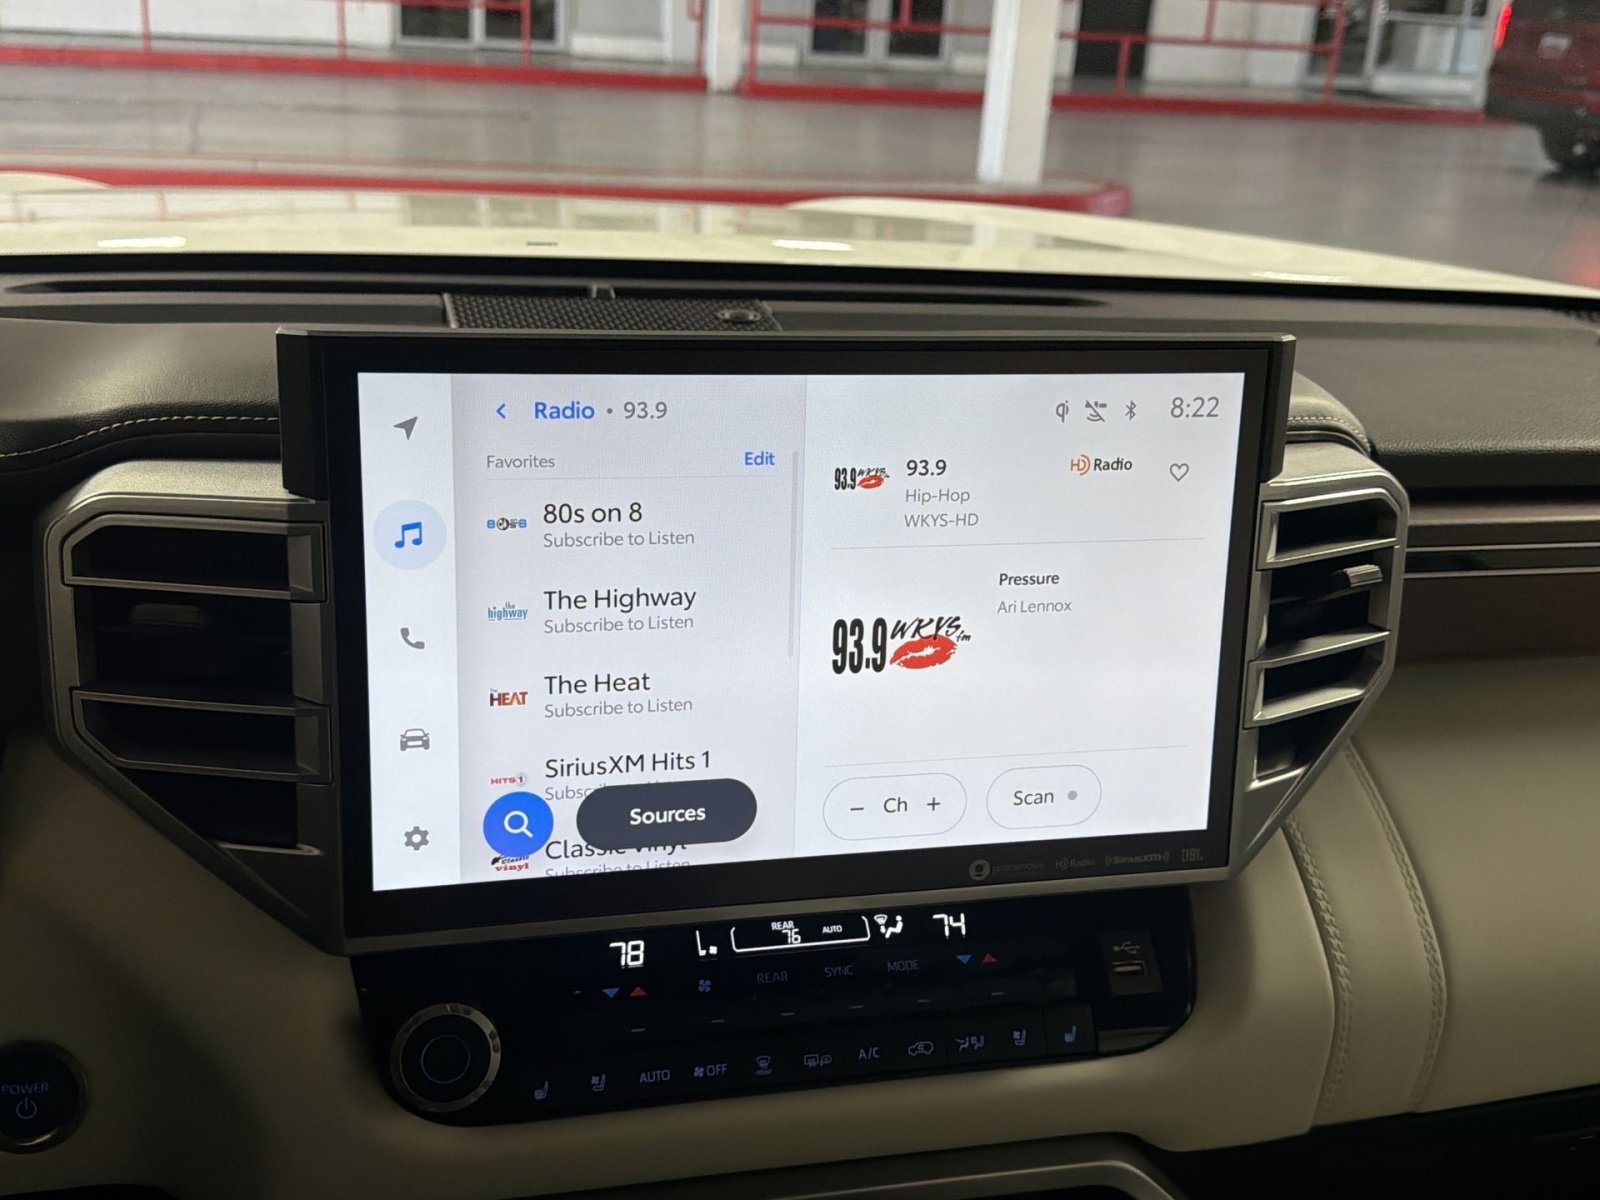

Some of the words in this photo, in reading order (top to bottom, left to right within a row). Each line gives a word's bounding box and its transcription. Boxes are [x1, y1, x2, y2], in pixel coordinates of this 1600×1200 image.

[534, 401, 595, 420] Radio
[623, 401, 668, 420] 93.9
[1170, 396, 1220, 418] 8:22
[486, 454, 555, 470] Favorites
[744, 451, 776, 467] Edit
[1093, 457, 1133, 472] Radio
[906, 459, 947, 477] 93.9
[834, 467, 857, 490] 93.9
[905, 488, 971, 504] Hip-Hop
[543, 503, 585, 524] 80s
[591, 508, 622, 523] on
[628, 502, 643, 522] 8
[904, 512, 980, 528] WKYS-HD
[543, 531, 623, 548] Subscribe
[628, 531, 645, 546] to
[648, 529, 695, 546] Listen
[999, 572, 1060, 587] Pressure
[543, 590, 588, 611] The
[594, 588, 697, 613] Highway
[997, 599, 1017, 614] Ari
[1020, 598, 1073, 613] Lennox
[487, 606, 528, 621] highway
[543, 617, 623, 634] Subscribe
[628, 616, 645, 631] to
[648, 614, 694, 631] Listen
[831, 617, 888, 675] 93.9
[890, 616, 961, 641] WKYS
[544, 674, 588, 695] The
[594, 673, 651, 693] Heat
[489, 691, 529, 707] HEAT
[544, 702, 623, 719] Subscribe
[627, 701, 643, 715] to
[647, 698, 693, 714] Listen
[545, 755, 645, 778] SiriusXM
[652, 752, 696, 772] Hits
[701, 751, 711, 768] 1
[883, 797, 908, 813] Ch
[1013, 789, 1055, 806] Scan
[629, 807, 707, 826] Sources
[772, 921, 796, 935] REAR
[822, 923, 847, 935] AUTO
[933, 913, 966, 938] 74
[785, 930, 802, 945] 76
[609, 939, 645, 967] 78
[824, 964, 854, 978] SYNC
[887, 959, 921, 973] MODE
[756, 971, 789, 985] REAR
[858, 1045, 881, 1061] A/C
[639, 1069, 671, 1084] AUTO
[706, 1063, 729, 1077] OFF
[1, 1082, 50, 1095] POWER
